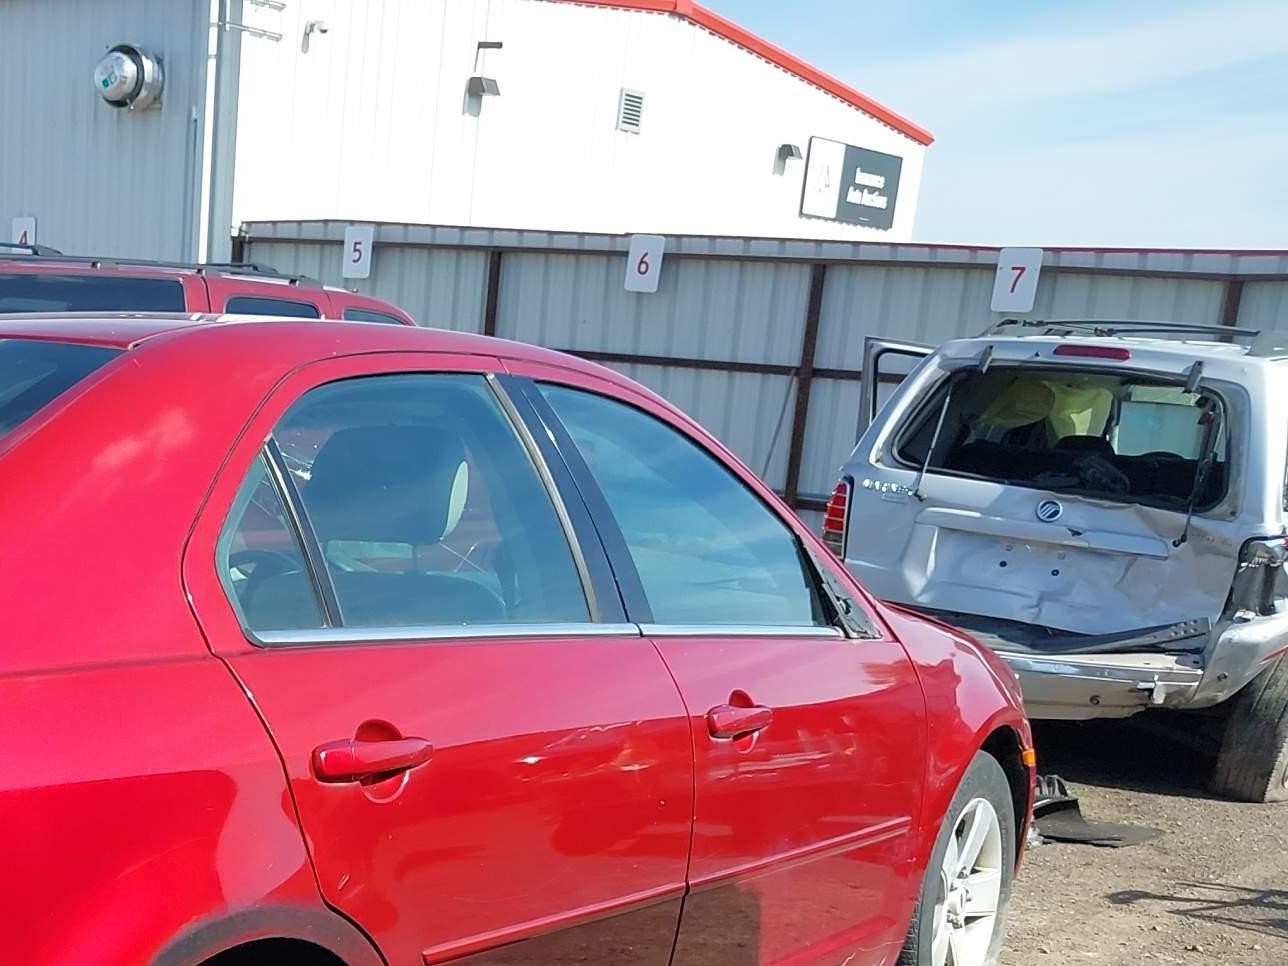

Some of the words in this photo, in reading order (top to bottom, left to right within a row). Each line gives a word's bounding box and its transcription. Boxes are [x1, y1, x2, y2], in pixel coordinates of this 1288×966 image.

[352, 241, 362, 264] 5
[637, 251, 649, 275] 6
[1010, 266, 1026, 294] 7
